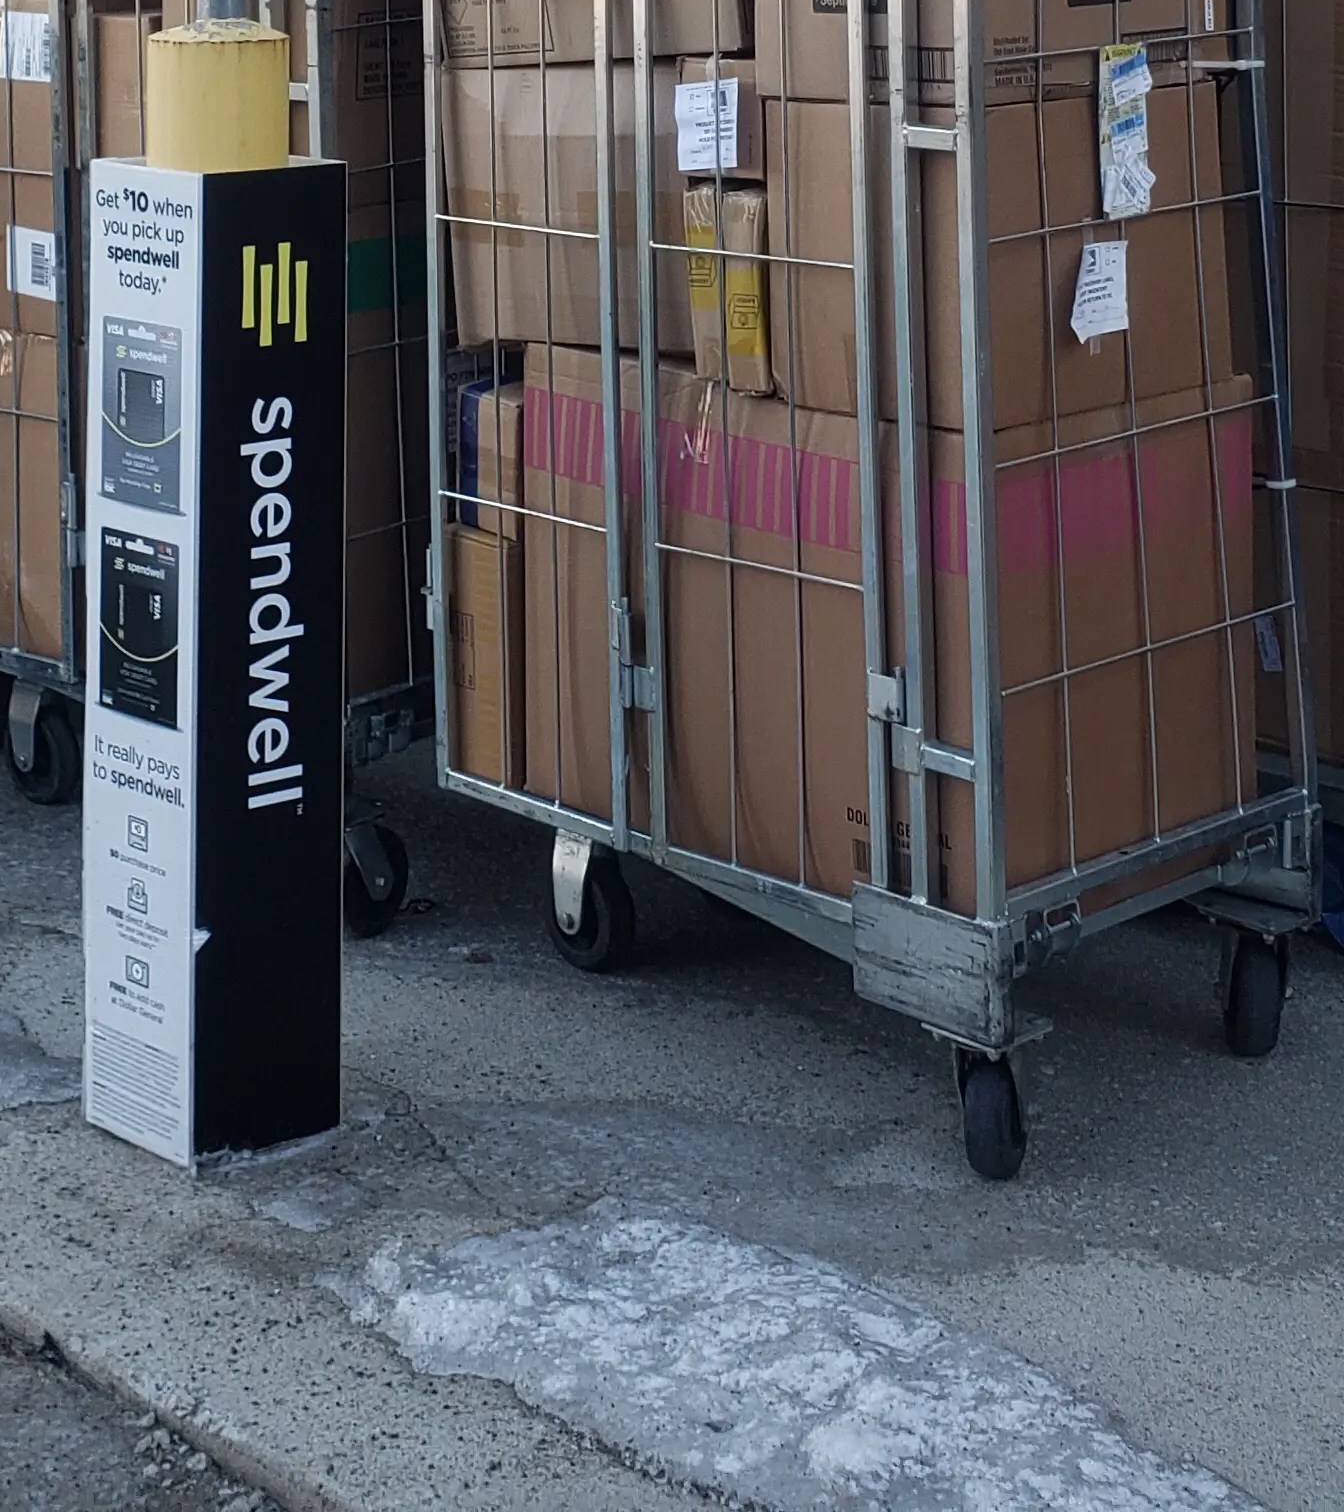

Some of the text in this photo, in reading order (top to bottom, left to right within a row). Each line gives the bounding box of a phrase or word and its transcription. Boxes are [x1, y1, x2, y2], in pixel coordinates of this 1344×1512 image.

[96, 187, 193, 220] Get $10 when
[103, 218, 185, 248] you pick up
[106, 244, 180, 270] spendwell
[106, 323, 125, 337] VISA
[128, 347, 168, 365] spendwell
[155, 378, 164, 406] VISA
[105, 534, 123, 548] VISA
[127, 561, 166, 581] spendwell
[154, 593, 162, 621] VISA
[240, 395, 305, 811] spendwell
[93, 734, 180, 781] It really pays
[92, 759, 185, 809] to spendwell.
